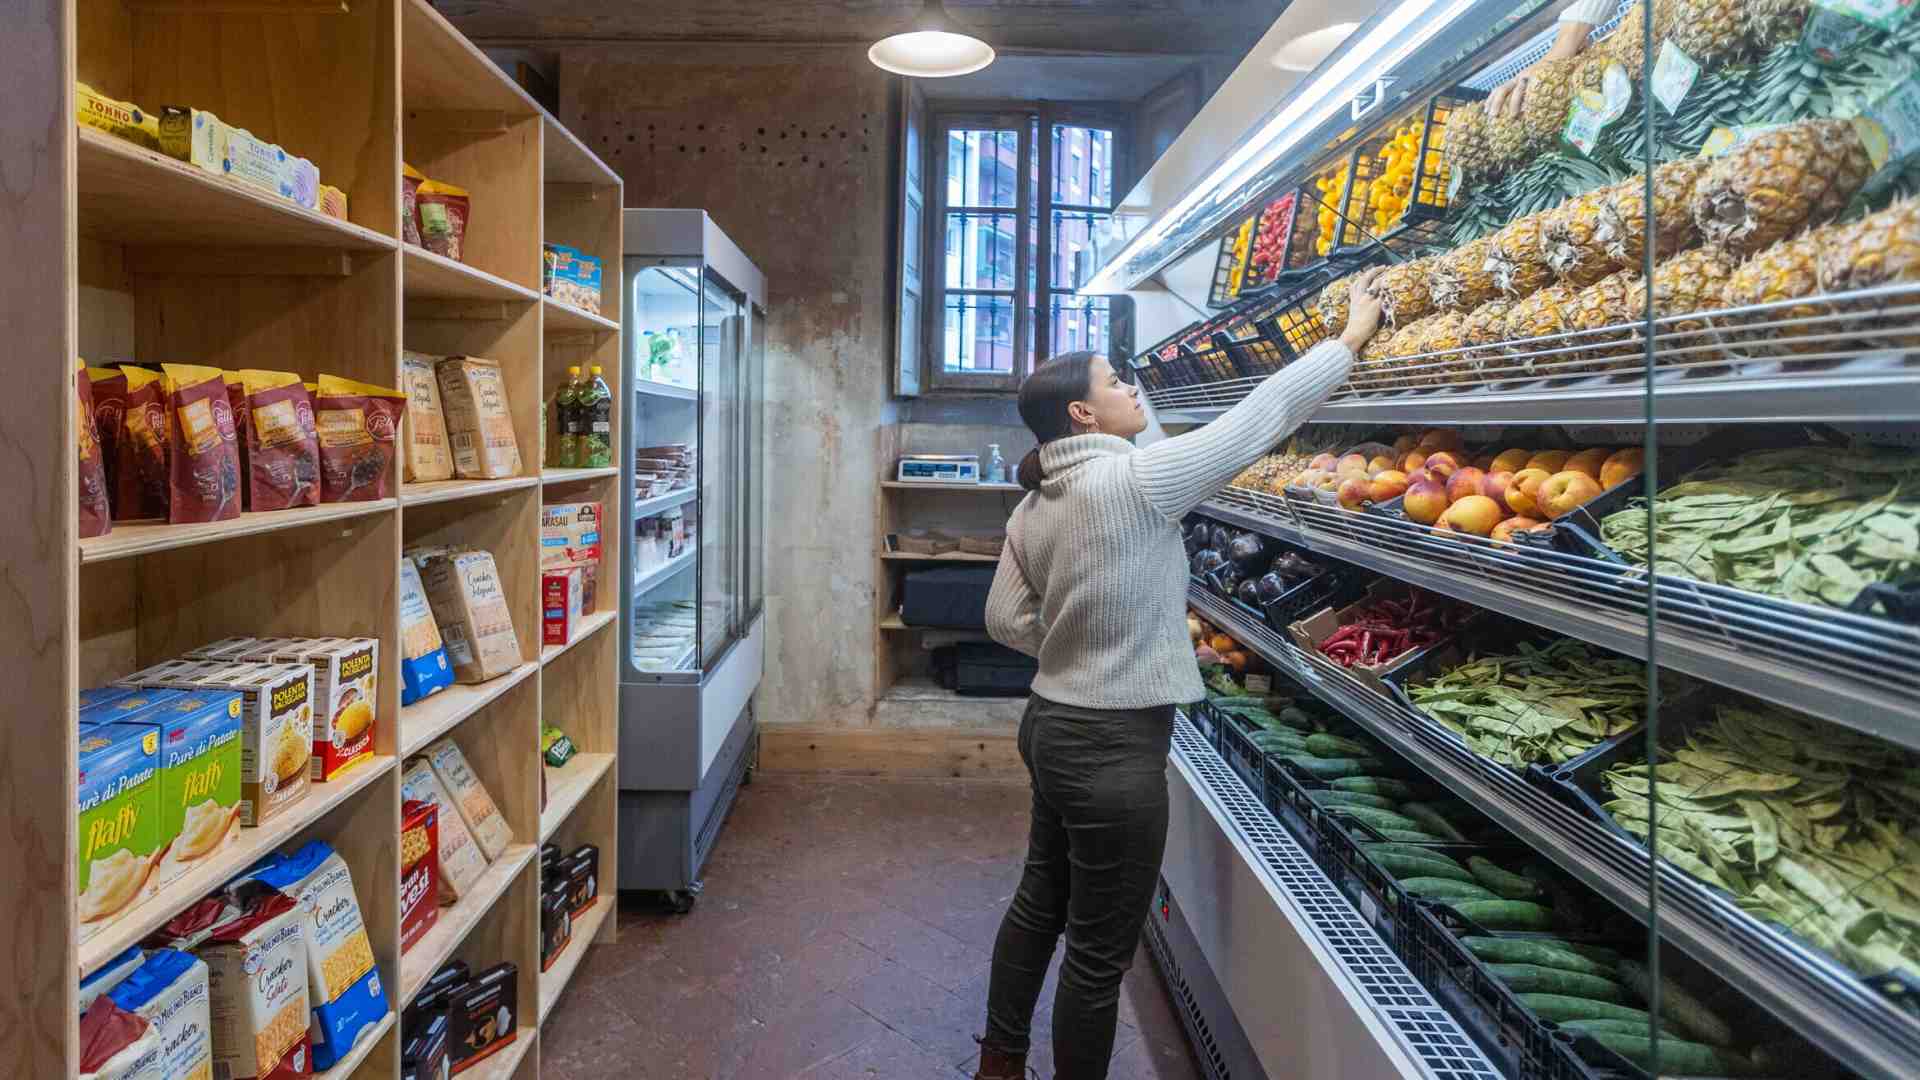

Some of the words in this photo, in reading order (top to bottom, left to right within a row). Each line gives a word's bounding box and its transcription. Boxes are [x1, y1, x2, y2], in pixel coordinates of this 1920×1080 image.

[87, 98, 131, 123] TONNO
[273, 681, 306, 705] POLENTA
[196, 739, 207, 757] di
[79, 787, 101, 812] urè
[102, 781, 116, 802] di
[118, 766, 154, 796] Patate
